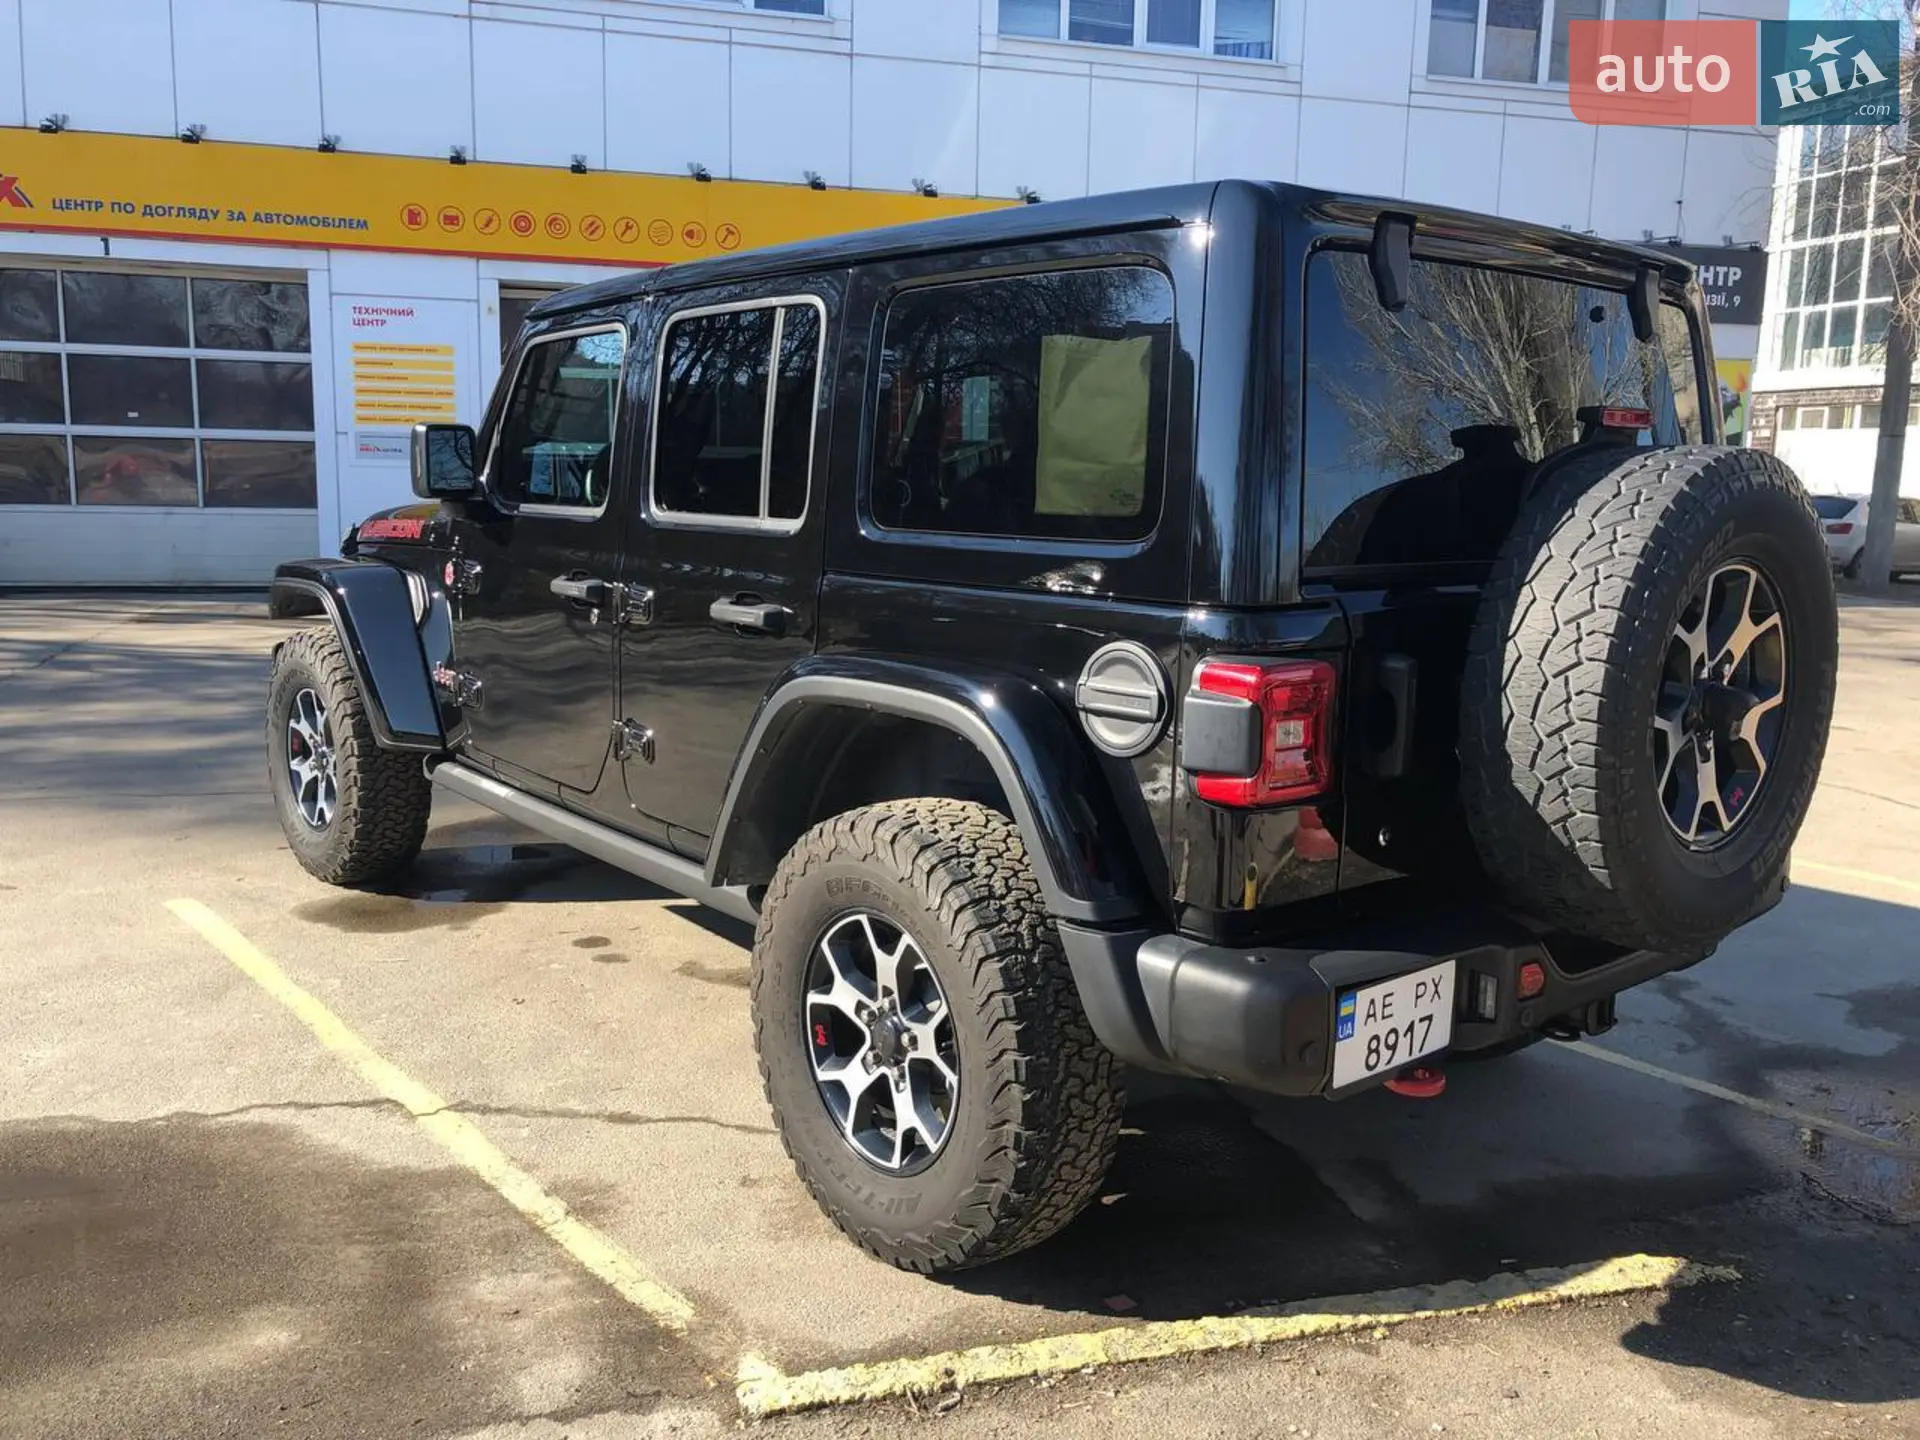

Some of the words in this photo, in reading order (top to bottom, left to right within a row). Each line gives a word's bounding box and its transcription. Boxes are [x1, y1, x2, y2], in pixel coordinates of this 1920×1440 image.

[52, 198, 104, 212] ЦЕНТР
[110, 202, 136, 214] ПО
[142, 204, 220, 221] ДОГЛЯДУ
[227, 210, 247, 222] ЗА
[253, 211, 370, 230] АВТОМОБІЛЕМ
[1693, 264, 1742, 287] НТР
[1733, 295, 1741, 307] 9
[352, 306, 414, 317] ТЕХНІЧНИЙ
[352, 318, 387, 327] ЦЕНТР
[1363, 991, 1395, 1027] AE
[1413, 973, 1443, 1009] PX
[1337, 1021, 1353, 1039] UA
[1364, 1013, 1434, 1072] 8917
